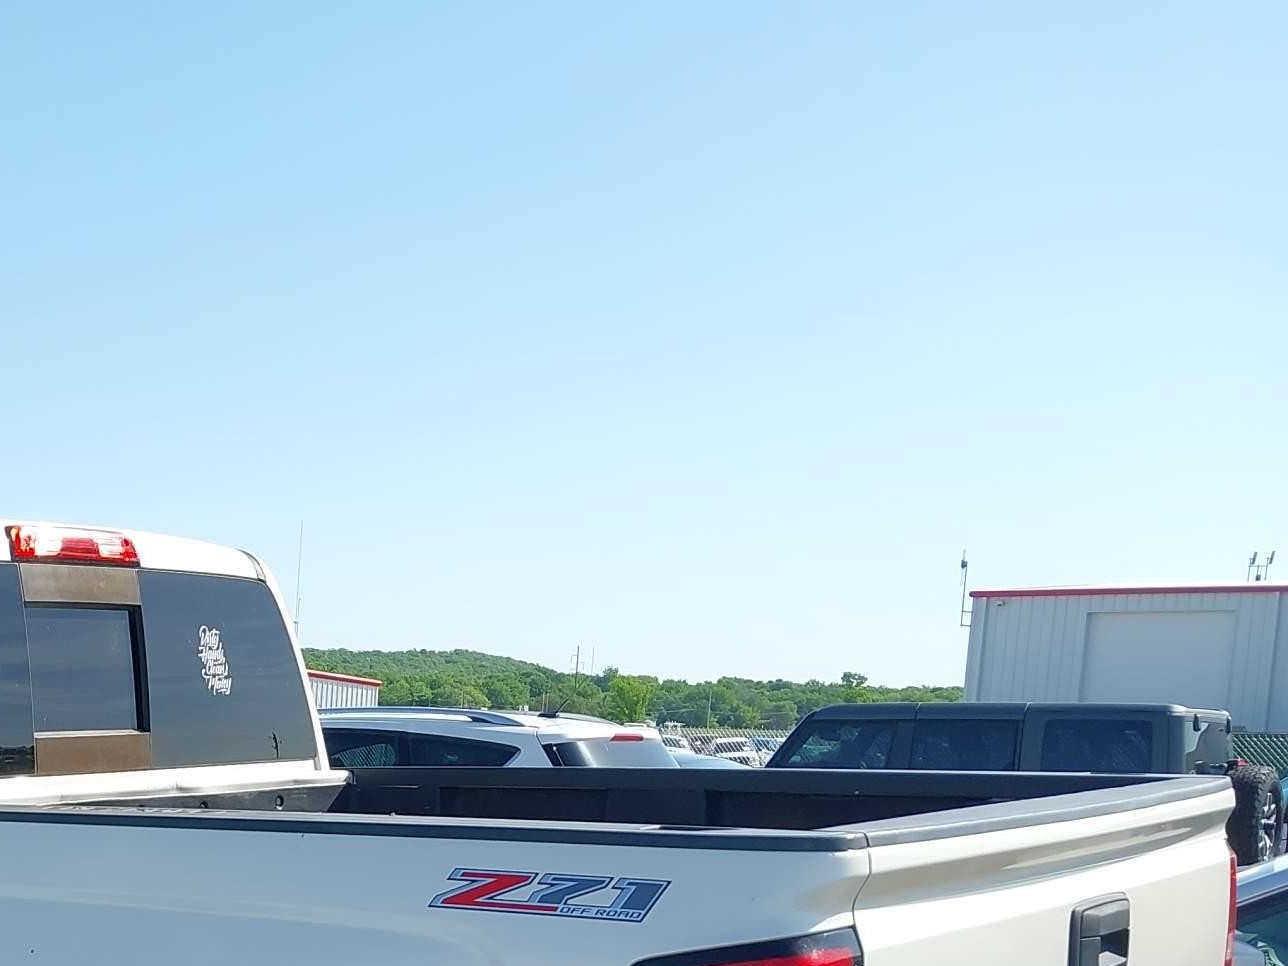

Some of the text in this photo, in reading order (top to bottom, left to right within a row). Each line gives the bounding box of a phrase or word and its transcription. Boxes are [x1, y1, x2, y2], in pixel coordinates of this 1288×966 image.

[429, 868, 672, 922] Z71
[559, 906, 643, 919] OFF ROAD
